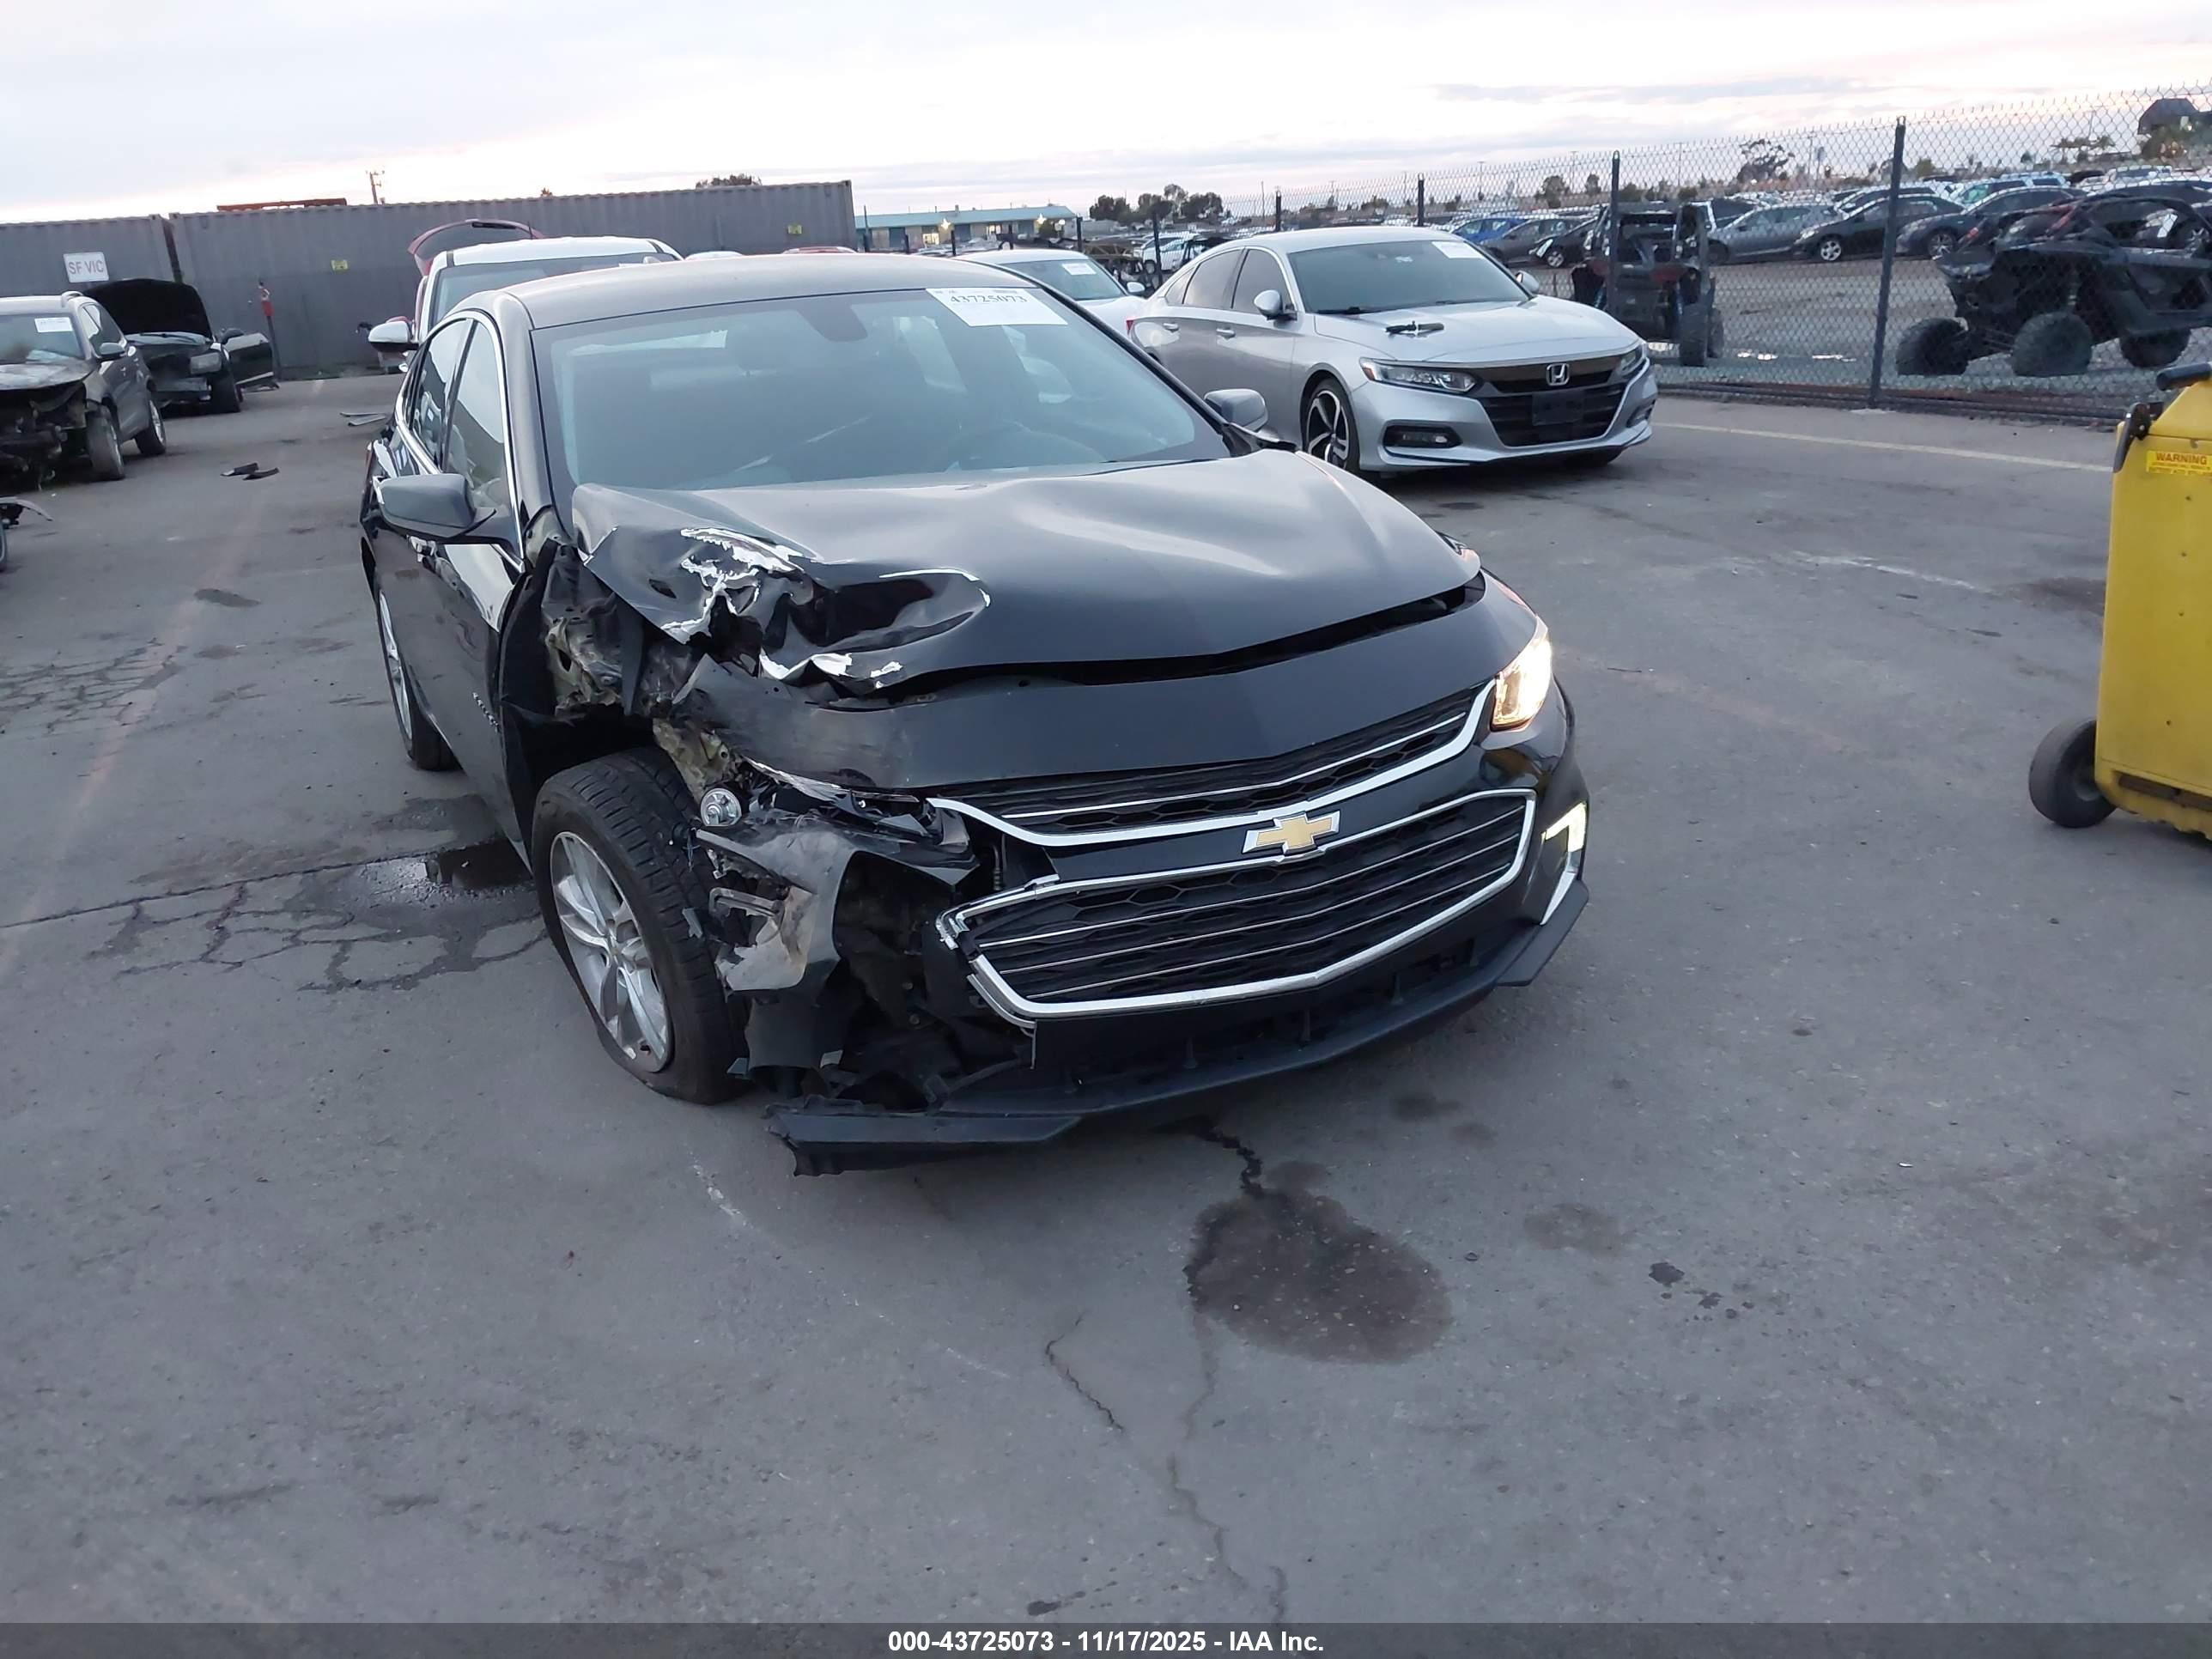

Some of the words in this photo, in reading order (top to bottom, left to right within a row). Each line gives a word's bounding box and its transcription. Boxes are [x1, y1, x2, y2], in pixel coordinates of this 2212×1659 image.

[68, 261, 83, 275] SF
[84, 259, 104, 274] VIC
[949, 295, 1029, 304] 43725073
[2156, 452, 2208, 465] WARNING
